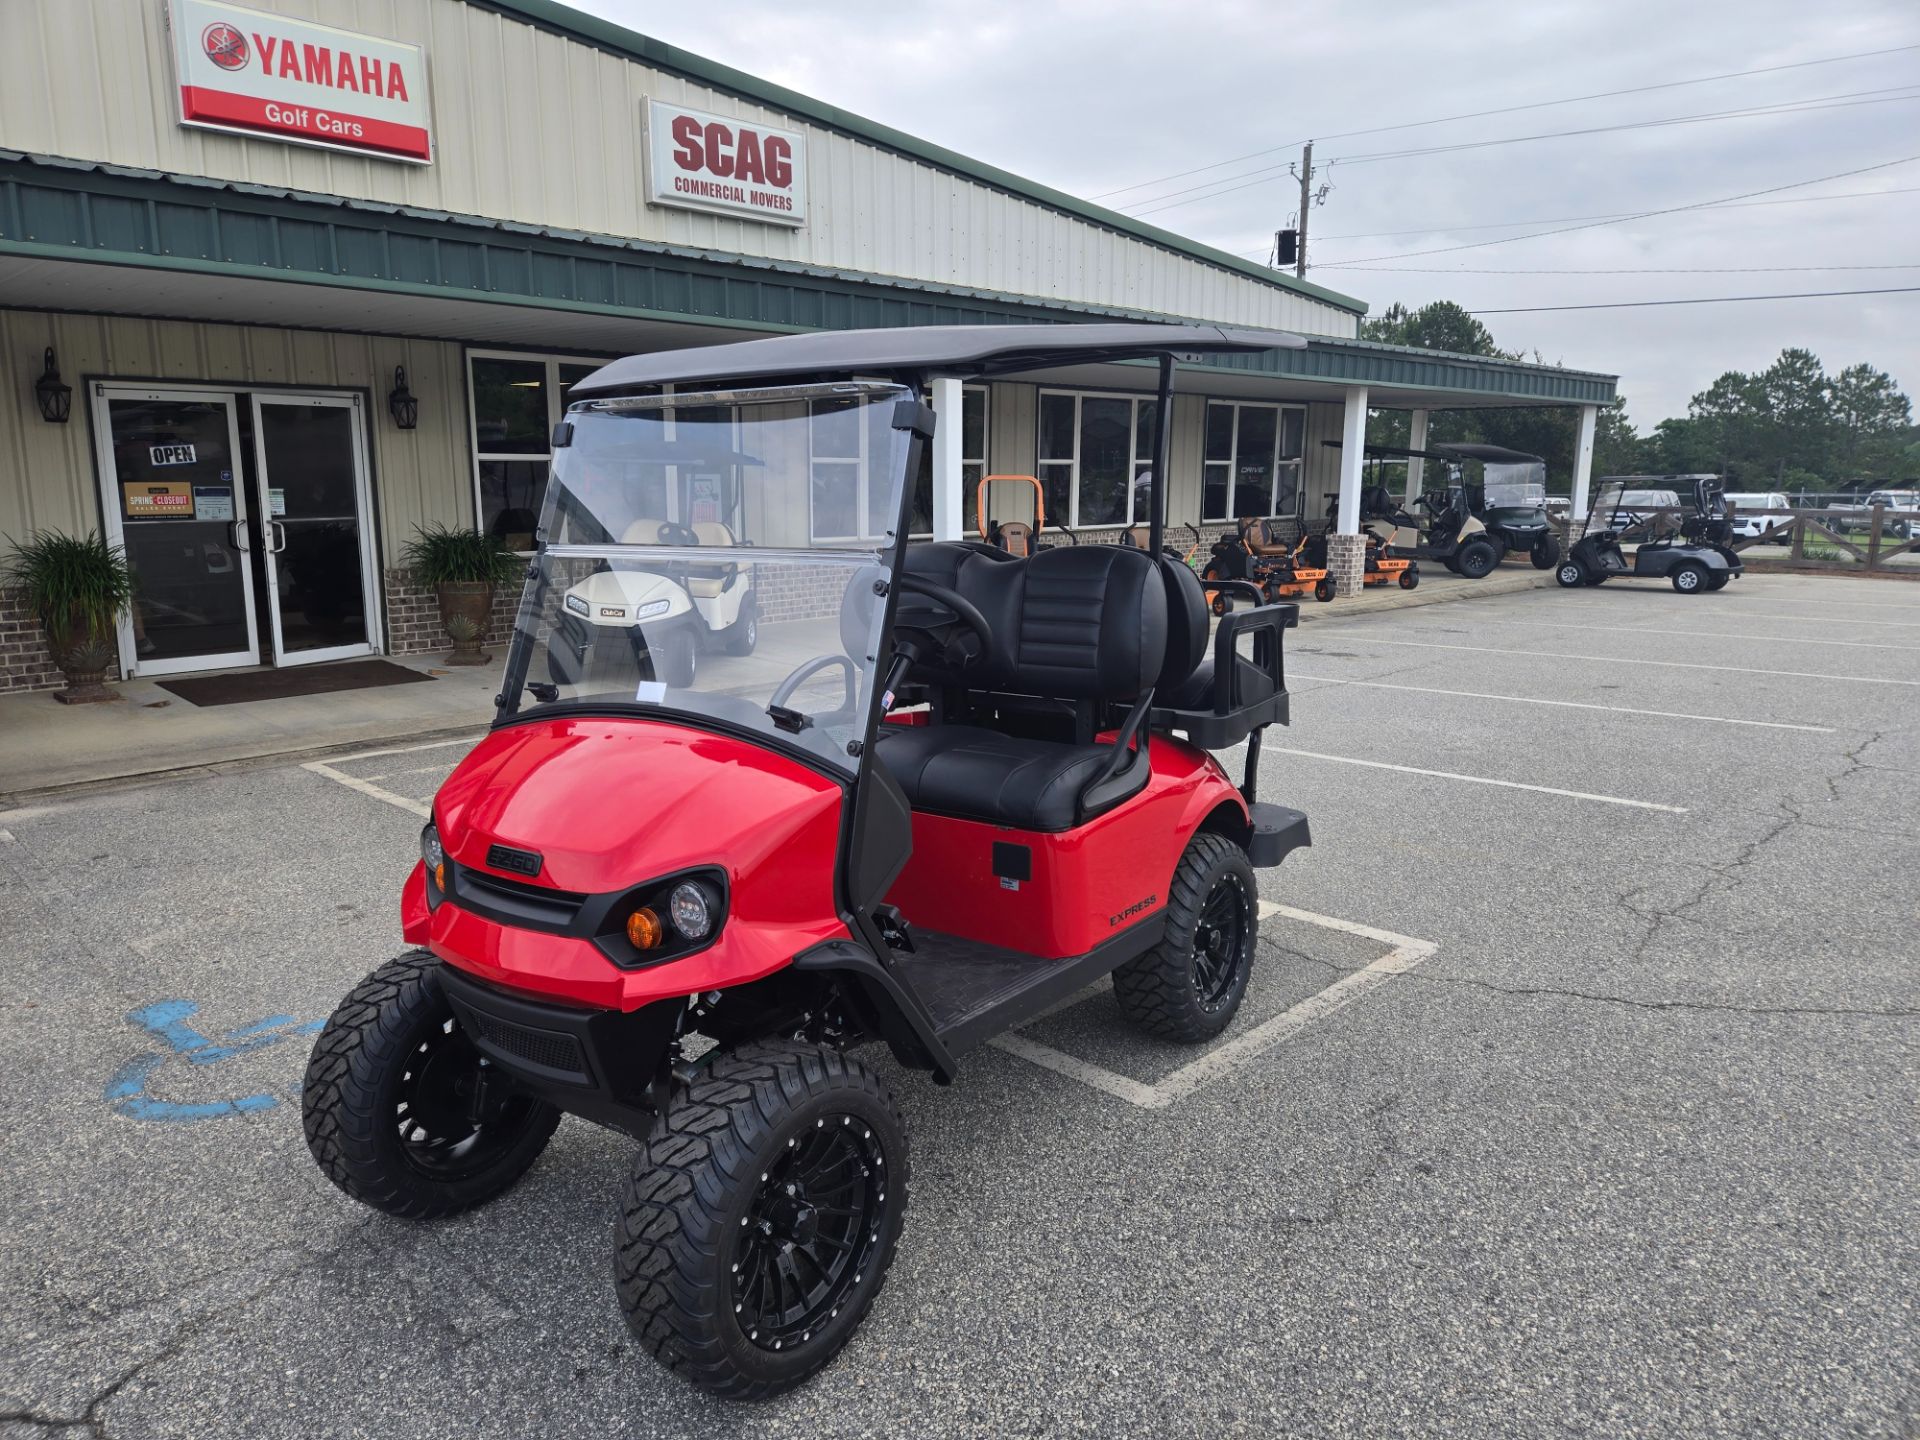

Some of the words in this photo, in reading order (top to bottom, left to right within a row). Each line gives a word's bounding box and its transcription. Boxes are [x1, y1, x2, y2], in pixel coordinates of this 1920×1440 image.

[252, 33, 408, 103] YAMAHA
[265, 103, 309, 128] Golf
[315, 113, 363, 137] Cars
[672, 115, 793, 188] SCAG
[674, 176, 746, 203] COMMERCIAL
[750, 190, 793, 212] MOWERS
[153, 446, 194, 464] OPEN
[156, 495, 187, 505] CLOSEOUT
[1110, 894, 1156, 926] EXPRESS
